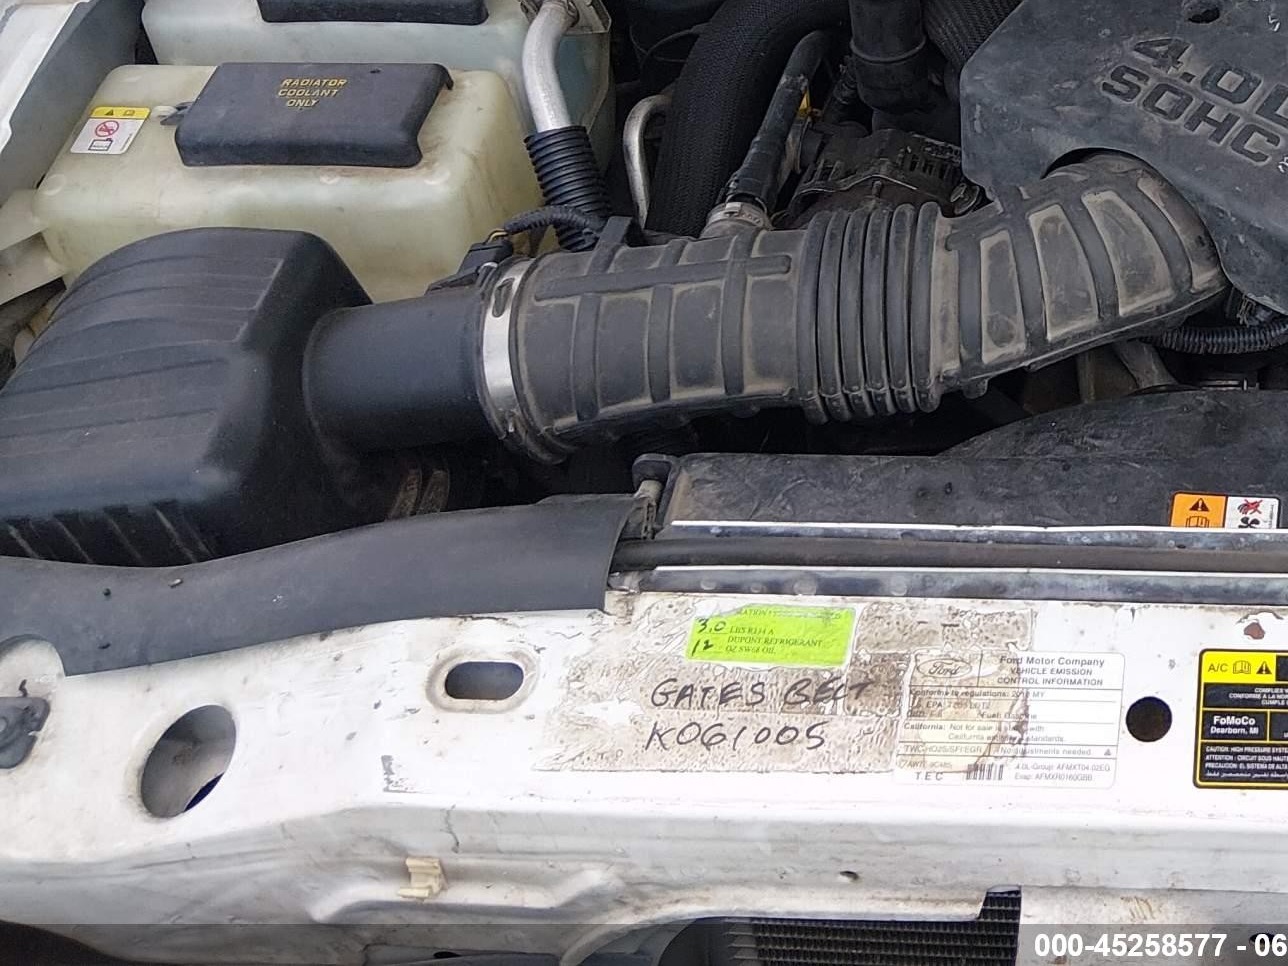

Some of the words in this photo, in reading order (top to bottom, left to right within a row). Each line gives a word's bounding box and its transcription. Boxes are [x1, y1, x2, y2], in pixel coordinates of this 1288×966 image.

[281, 78, 347, 87] RADIATOR
[278, 88, 339, 97] COOLANT
[287, 98, 320, 107] ONLY
[1102, 65, 1281, 163] SOHC
[1000, 655, 1023, 665] Ford
[1026, 656, 1055, 666] Motor
[1057, 657, 1105, 668] Company
[928, 660, 961, 677] Ford
[1050, 668, 1093, 676] EMISSION
[1208, 663, 1228, 673] A/C
[997, 677, 1040, 685] CONTROL
[1042, 678, 1104, 686] INFORMATION
[651, 678, 766, 707] GATES
[780, 676, 876, 706] BELT
[1213, 715, 1256, 726] FoMoCo
[1210, 726, 1248, 735] Dearborn,
[1249, 727, 1259, 735] MI
[645, 721, 829, 751] K061005
